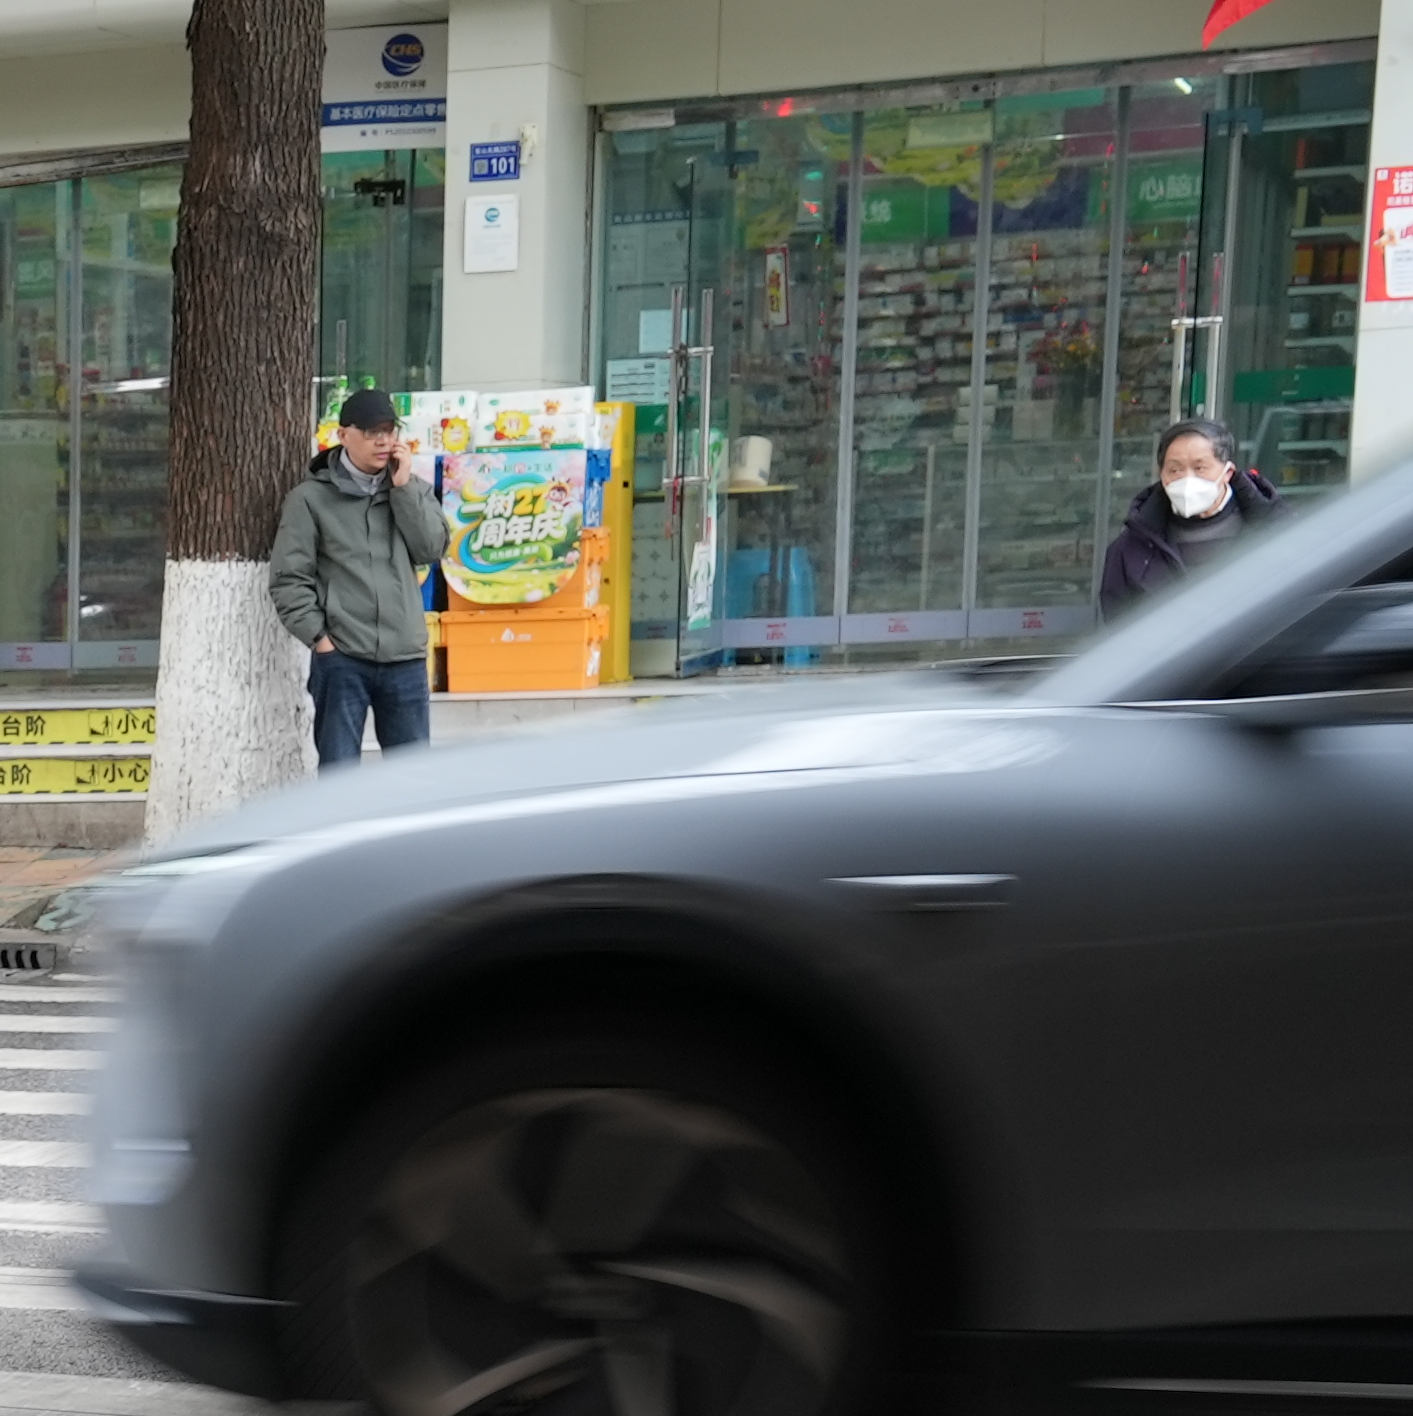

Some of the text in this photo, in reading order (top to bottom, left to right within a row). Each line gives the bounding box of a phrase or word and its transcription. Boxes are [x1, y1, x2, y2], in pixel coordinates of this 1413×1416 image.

[490, 156, 515, 175] 101
[469, 508, 565, 553] 周年庆
[103, 761, 149, 784] 小心
